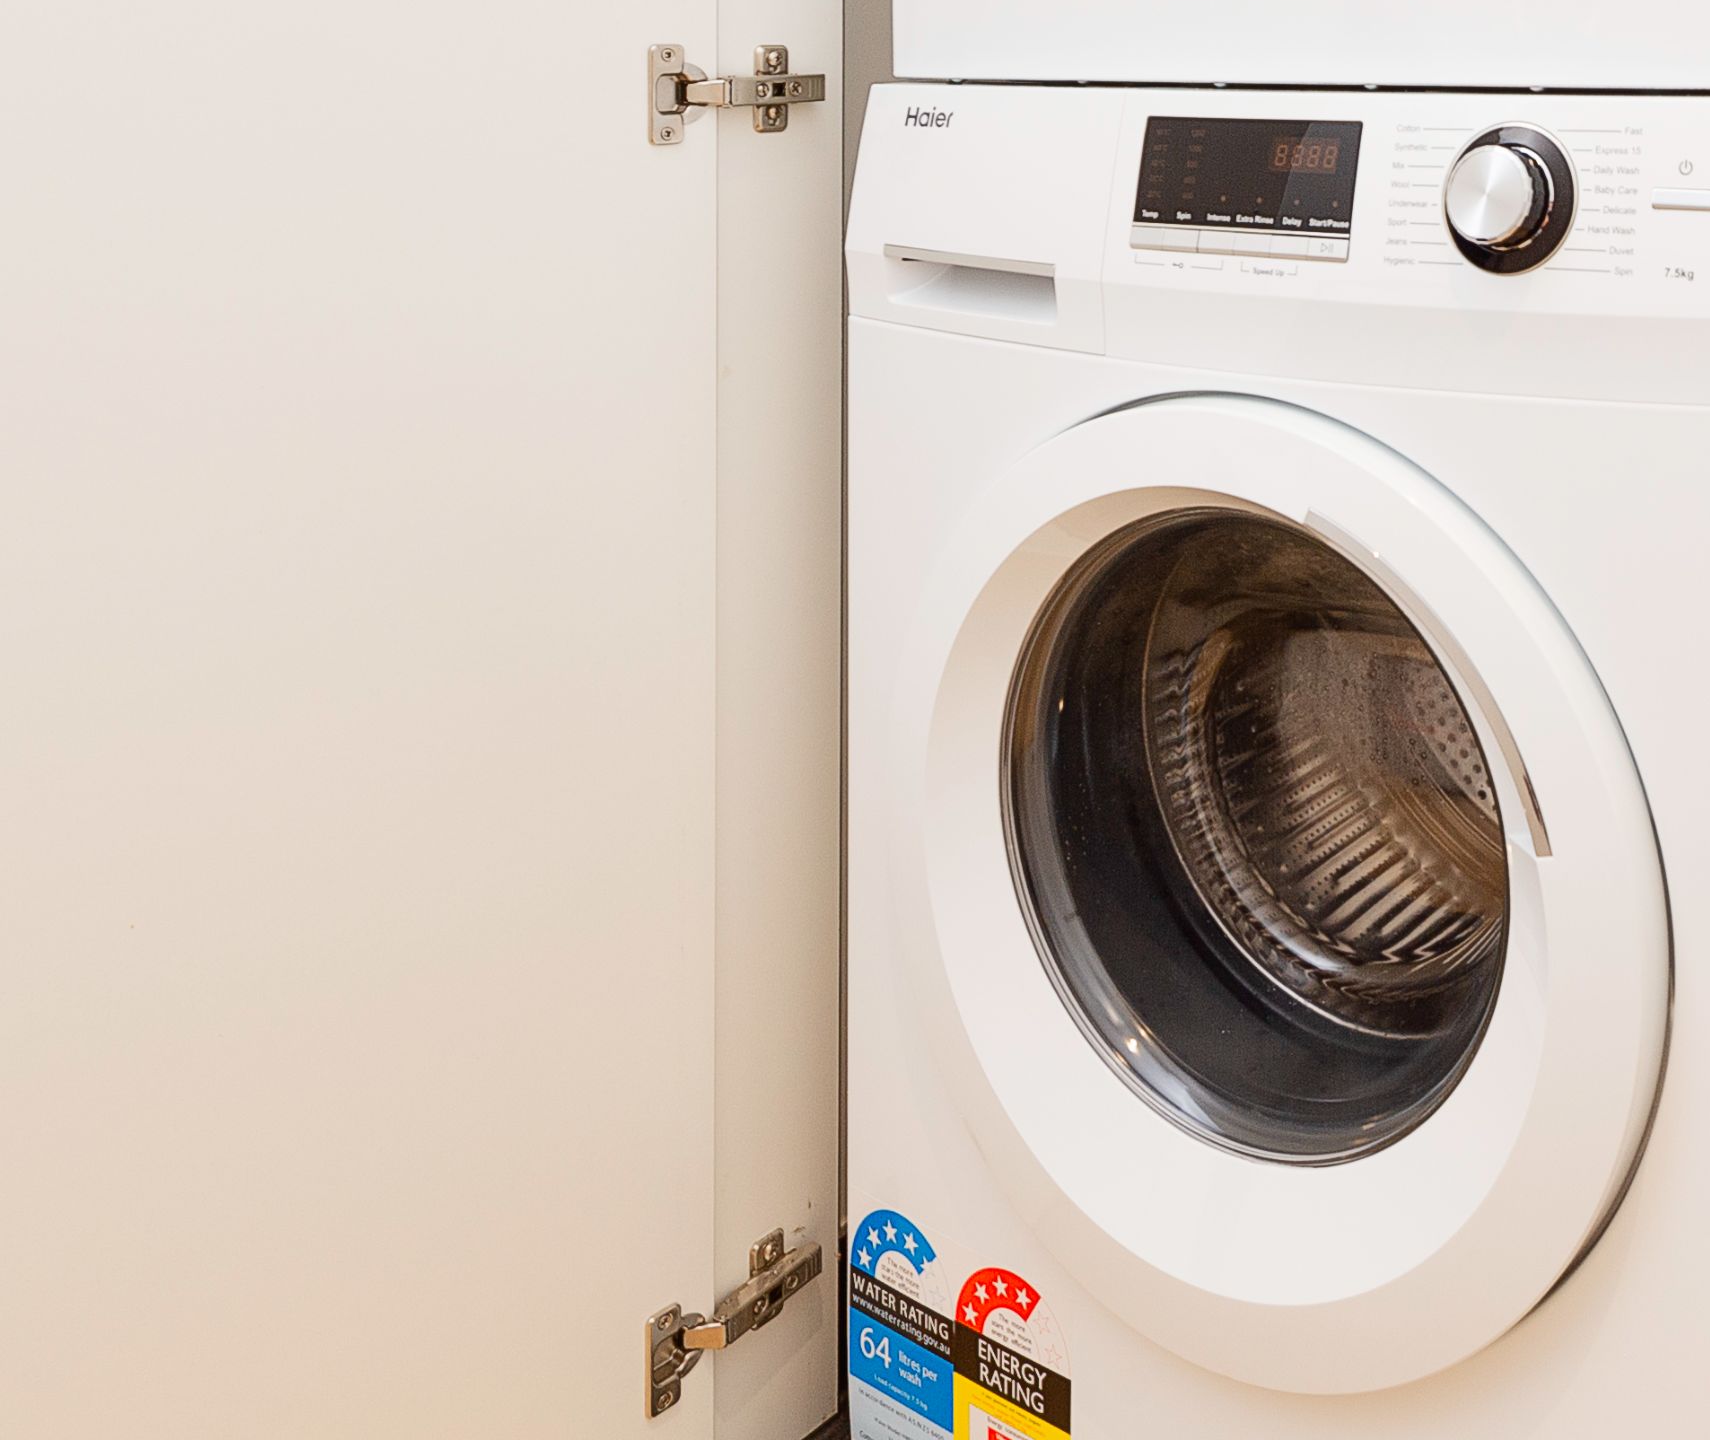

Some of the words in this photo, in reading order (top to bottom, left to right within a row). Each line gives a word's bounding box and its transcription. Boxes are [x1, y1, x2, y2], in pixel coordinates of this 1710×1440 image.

[904, 106, 954, 128] Haier
[1396, 123, 1421, 133] Cotton
[1624, 126, 1643, 136] Fast
[1394, 142, 1428, 153] Synthetic
[1595, 144, 1628, 156] Express
[1631, 145, 1641, 155] 15
[1391, 161, 1405, 169] Mix
[1593, 164, 1614, 176] Daily
[1616, 165, 1640, 175] Wash
[1391, 180, 1410, 189] Wool
[1594, 185, 1615, 196] Baby
[1617, 185, 1638, 195] Care
[1388, 200, 1428, 208] Underwear
[1602, 205, 1637, 216] Delicate
[1142, 209, 1160, 219] Temp
[1176, 211, 1192, 221] Spin
[1235, 214, 1254, 224] Extra
[1254, 215, 1274, 225] Rinse
[1282, 216, 1302, 228] Delay
[1308, 217, 1350, 229] Start/Pause
[1387, 217, 1407, 228] Sport
[1587, 224, 1610, 234] Hand
[1612, 225, 1636, 236] Wash
[1385, 238, 1407, 246] Jeans
[1608, 245, 1634, 256] Duvet
[1252, 267, 1273, 276] Speed
[1275, 268, 1285, 277] Up
[1613, 266, 1633, 277] Spin
[1663, 266, 1695, 282] 7.5kg
[899, 1264, 914, 1276] more
[852, 1272, 897, 1312] WATER
[899, 1299, 949, 1341] RATING
[852, 1293, 951, 1355] www.waterrating.gov.au
[1011, 1320, 1026, 1333] more
[860, 1327, 892, 1369] 64
[898, 1349, 921, 1373] litres
[922, 1366, 939, 1383] per
[978, 1338, 1047, 1391] ENERGY
[898, 1367, 922, 1388] wash
[979, 1362, 1045, 1414] RATING
